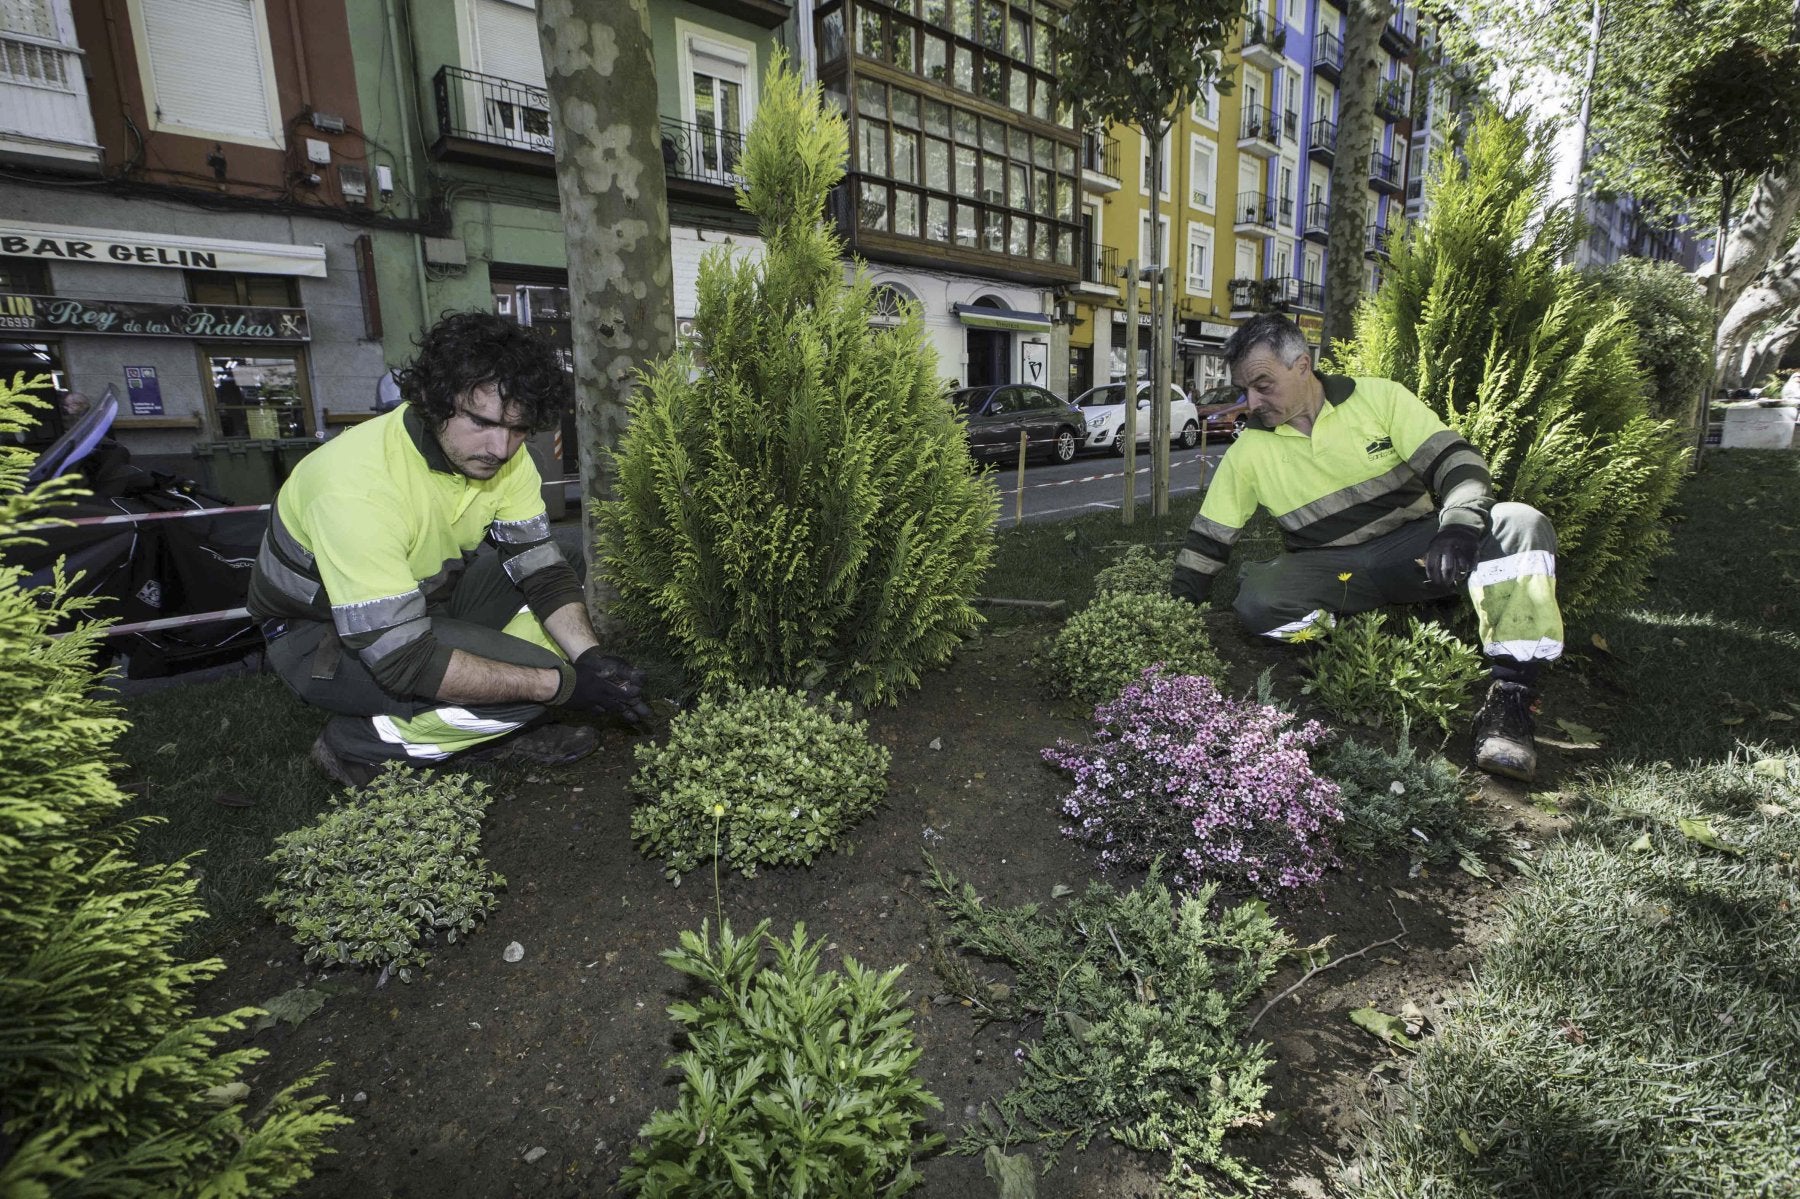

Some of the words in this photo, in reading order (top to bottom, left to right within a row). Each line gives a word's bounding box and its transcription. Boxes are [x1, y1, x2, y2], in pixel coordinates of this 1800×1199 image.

[0, 235, 97, 259] BAR
[108, 244, 217, 269] GELIN
[46, 299, 118, 332] Rey
[122, 319, 142, 333] de
[145, 319, 171, 334] las
[184, 312, 275, 337] Rabas
